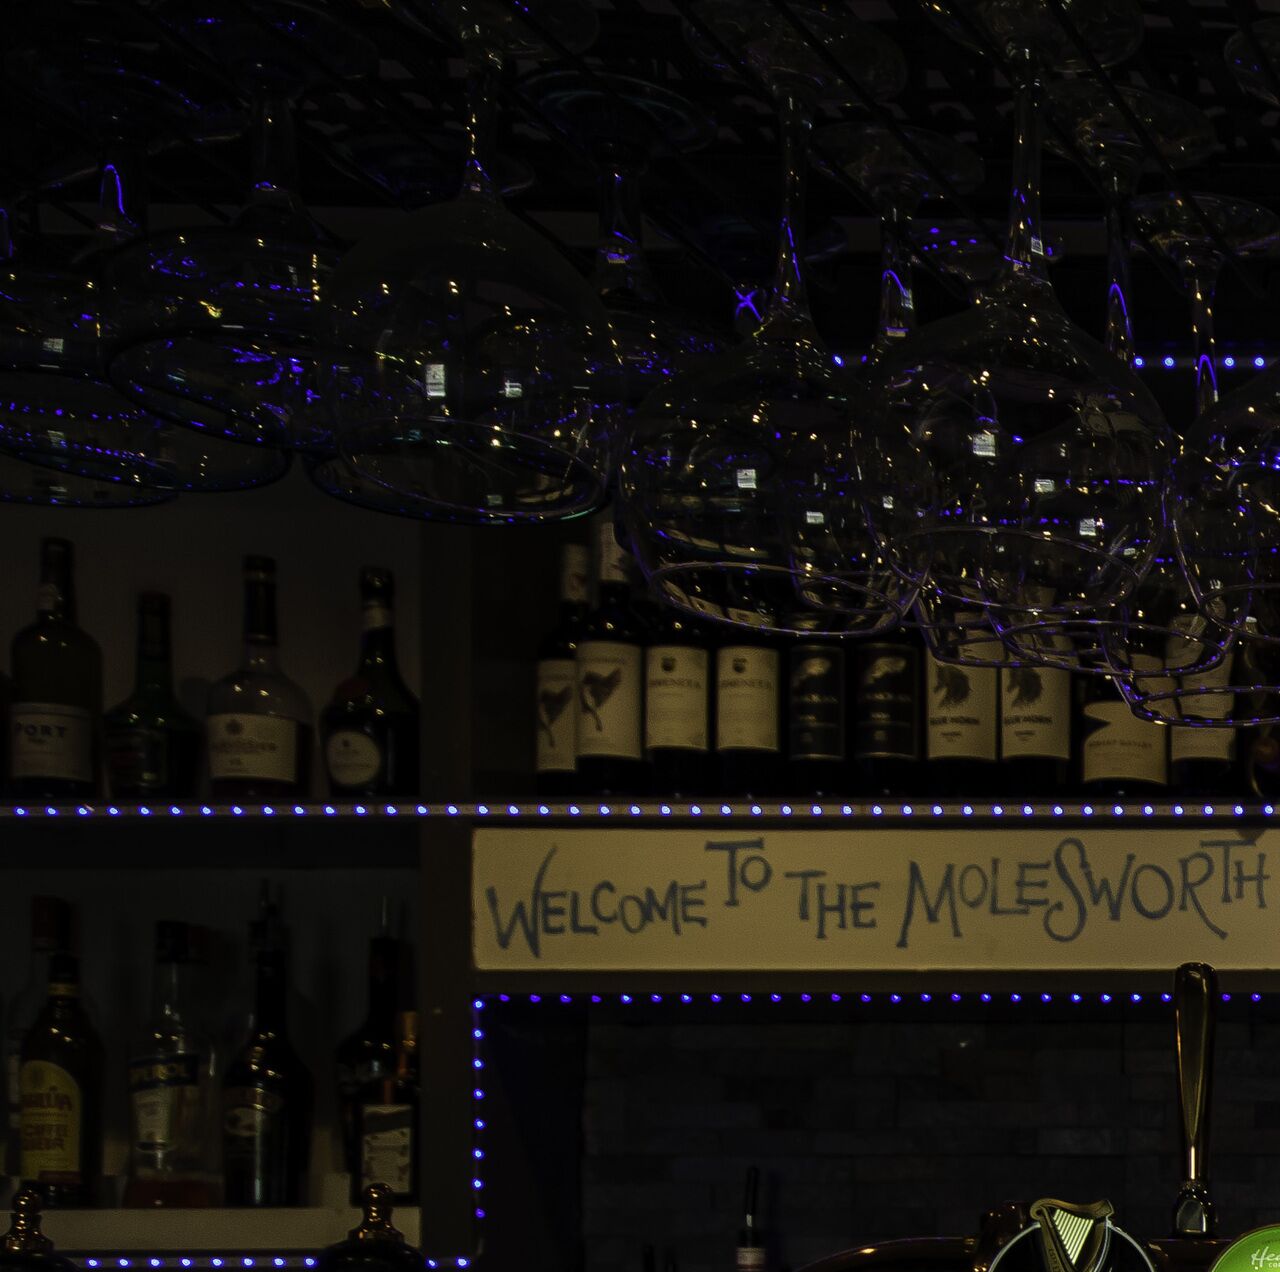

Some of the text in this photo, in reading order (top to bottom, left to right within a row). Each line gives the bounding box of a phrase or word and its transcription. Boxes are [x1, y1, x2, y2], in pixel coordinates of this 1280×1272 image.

[486, 845, 708, 958] WELCOME
[705, 838, 772, 906] TO
[784, 869, 881, 939] THE
[896, 837, 1270, 948] MOLESWORTH
